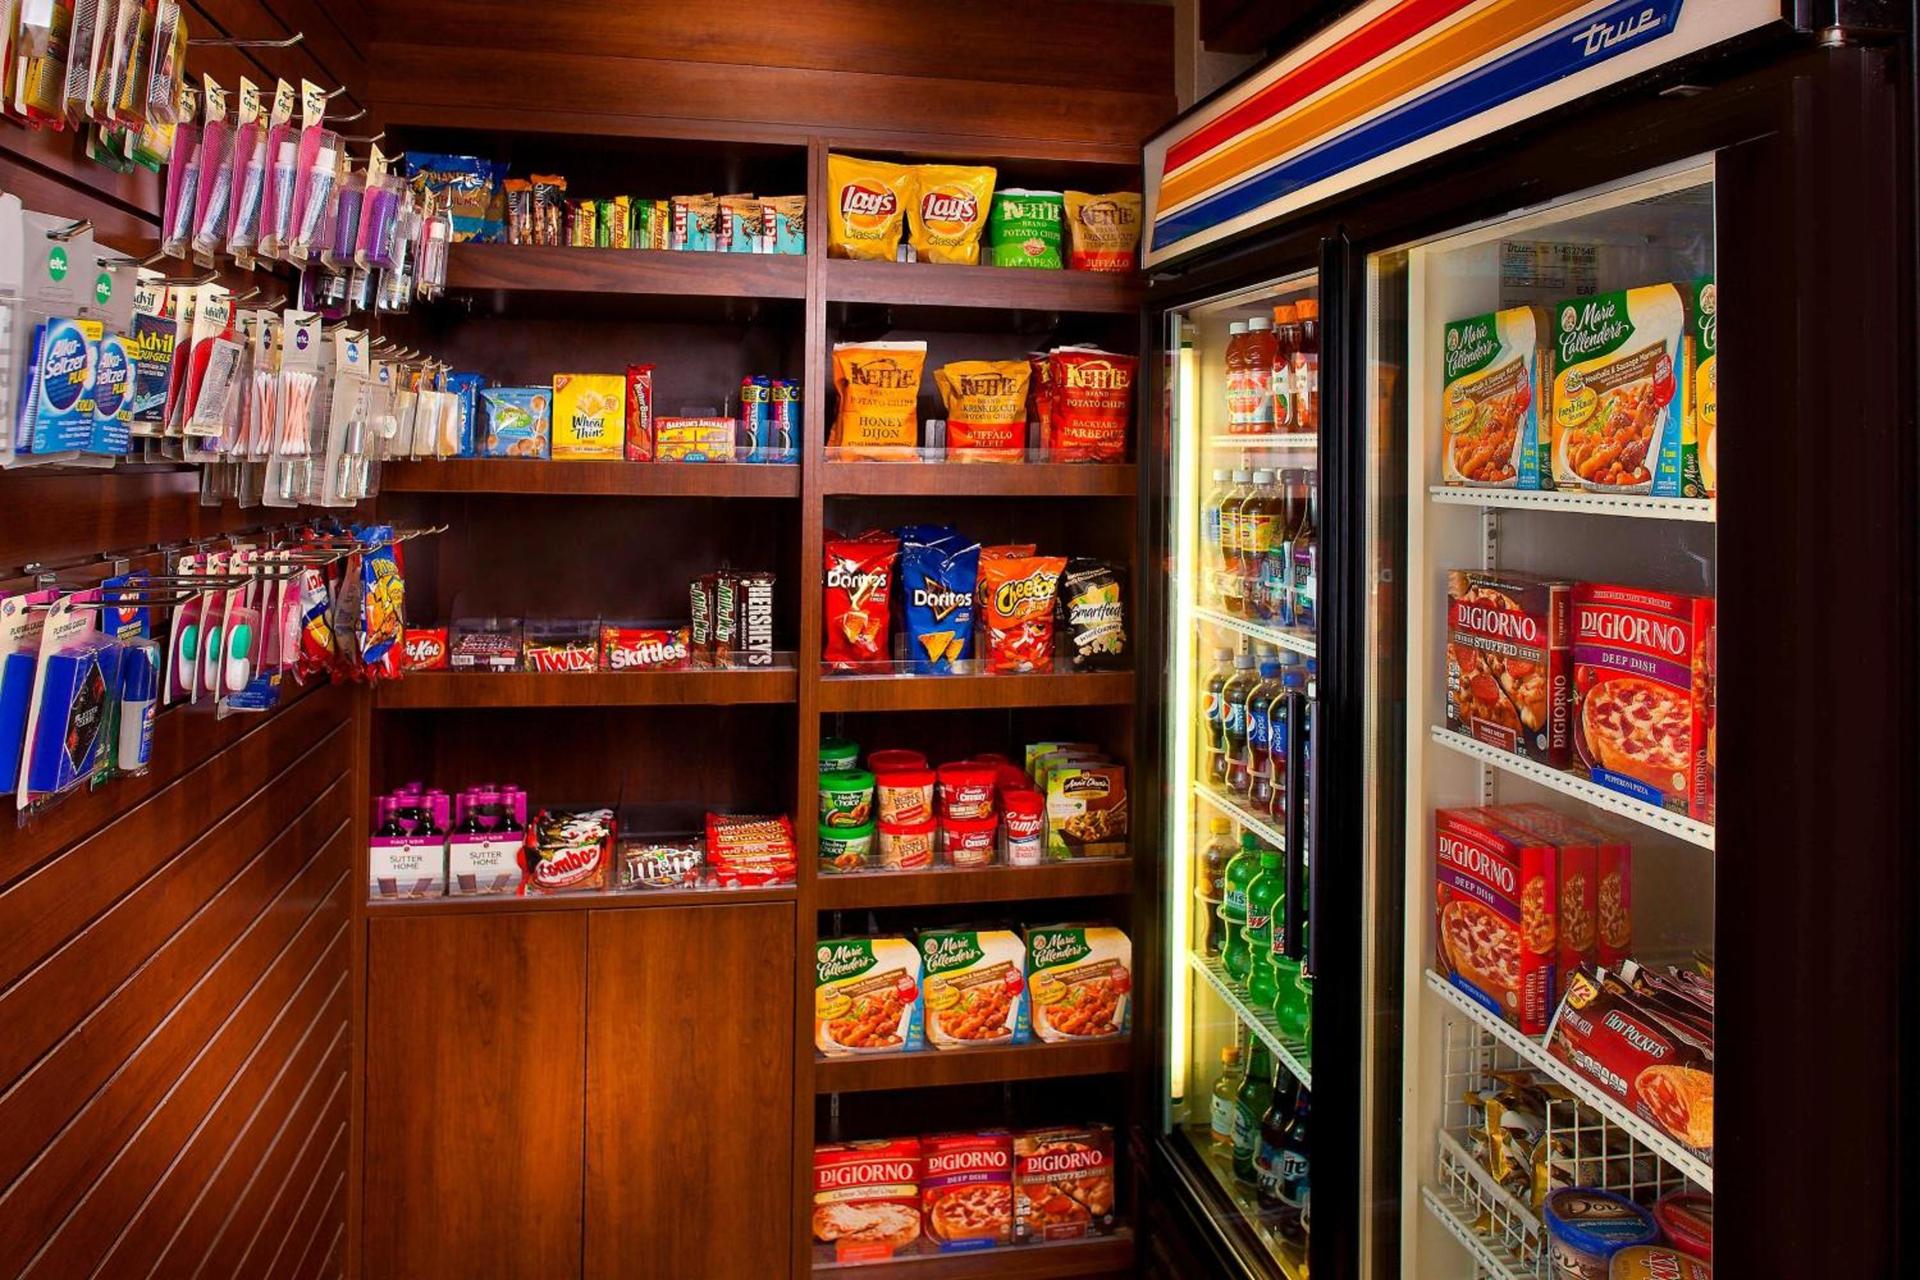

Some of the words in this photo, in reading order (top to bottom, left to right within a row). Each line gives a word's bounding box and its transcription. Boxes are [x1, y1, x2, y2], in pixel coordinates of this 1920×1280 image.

[1572, 8, 1661, 57] true
[243, 97, 257, 111] Crest
[307, 100, 322, 113] Crest
[509, 192, 518, 215] KIND
[843, 186, 894, 215] Lay's
[925, 194, 975, 222] Lay's
[845, 229, 884, 241] Classic
[927, 234, 965, 247] Classic
[50, 259, 68, 270] etc.
[1576, 301, 1616, 331] Marie
[138, 330, 174, 353] Advil
[1458, 323, 1488, 349] Marie
[1560, 321, 1629, 362] Callender's
[50, 338, 81, 360] Alka-
[1446, 341, 1497, 377] Callender's
[45, 355, 86, 378] Seltzer
[850, 359, 915, 388] KETTLE
[1064, 360, 1130, 389] KETTLE
[959, 373, 1020, 396] KETTLE
[1067, 400, 1100, 408] POTATO
[572, 414, 605, 428] Wheat
[859, 417, 904, 427] HONEY
[571, 427, 604, 439] Thins
[862, 429, 900, 443] DIJON
[828, 571, 887, 588] Doritos
[914, 590, 972, 606] Doritos
[996, 573, 1057, 616] Cheetos
[748, 583, 772, 665] HERSHEY'S
[1458, 605, 1536, 641] DIGIORNO
[1581, 611, 1686, 655] DIGIORNO
[611, 642, 687, 669] Skittles
[1474, 637, 1517, 656] STUFFED
[1602, 652, 1628, 665] DEEP
[1631, 658, 1656, 673] DISH
[1554, 675, 1567, 748] DIGIORNO
[1257, 715, 1266, 742] pepsi
[1274, 725, 1282, 752] pepsi
[834, 799, 860, 807] Choice
[389, 855, 423, 863] SUTTER
[1439, 837, 1515, 892] DIGIORNO
[1227, 892, 1245, 903] MIS
[1455, 876, 1475, 891] DEEP
[1476, 885, 1494, 904] DISH
[939, 937, 969, 954] Marie
[1046, 934, 1076, 949] Marie
[831, 945, 863, 962] Marie
[924, 948, 980, 972] Callender's
[1032, 944, 1088, 967] Callender's
[817, 956, 874, 981] Callender's
[1605, 1014, 1627, 1032] HOT
[1622, 1024, 1667, 1058] POCKETS
[928, 1151, 1007, 1172] DIGIORNO
[1027, 1150, 1102, 1172] DIGIORNO
[820, 1162, 914, 1187] DIGIORNO
[1047, 1170, 1087, 1182] STUFFED
